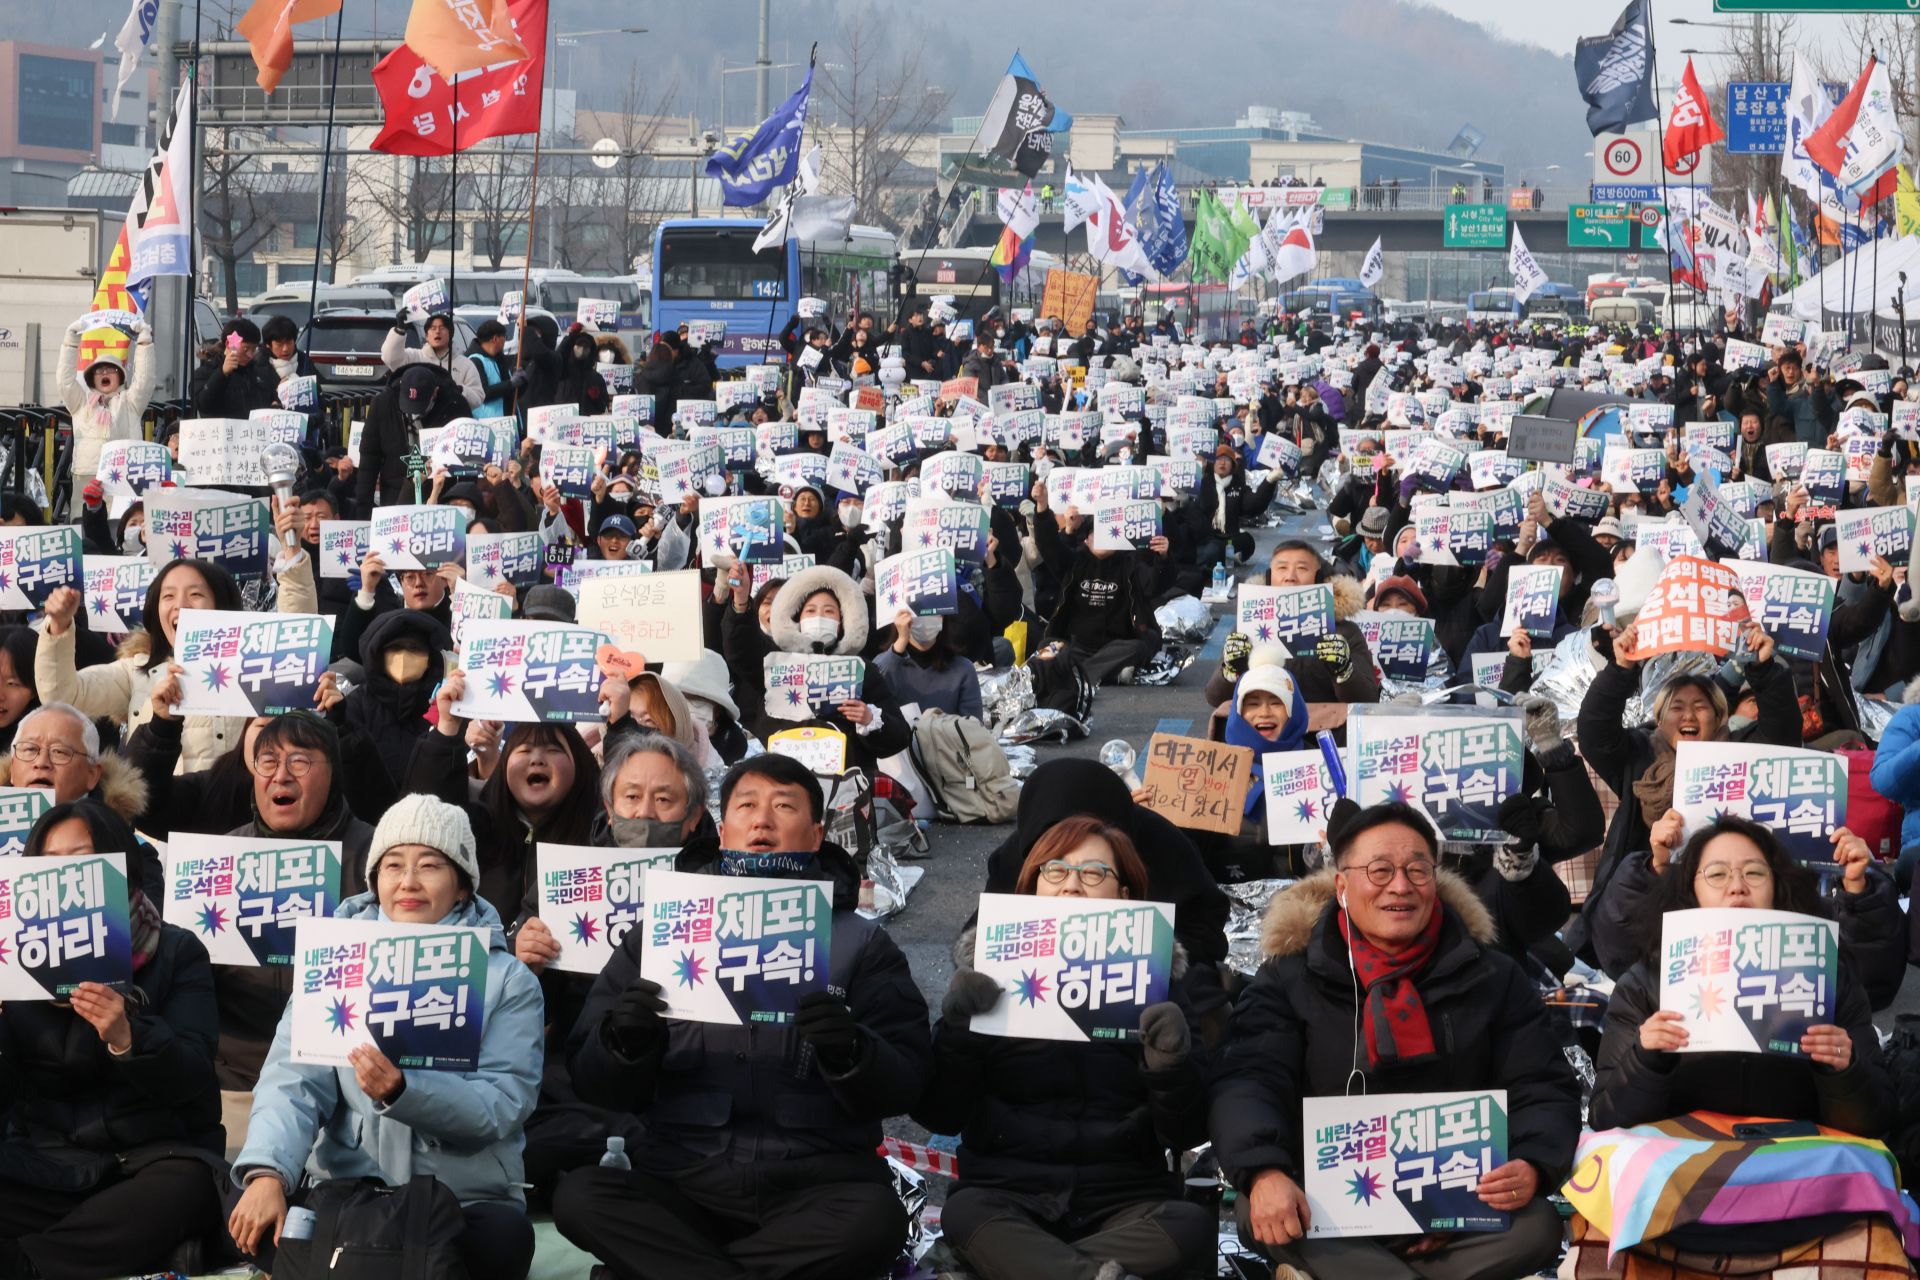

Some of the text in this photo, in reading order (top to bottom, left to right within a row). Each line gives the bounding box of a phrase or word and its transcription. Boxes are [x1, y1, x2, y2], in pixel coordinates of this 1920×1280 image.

[1615, 151, 1631, 163] 60
[1596, 187, 1648, 199] 전방600m
[1461, 211, 1477, 219] 시청
[1644, 211, 1656, 221] 60
[1460, 224, 1503, 233] 남산1호터널
[757, 281, 780, 296] 142
[0, 341, 19, 349] NDAI
[288, 379, 312, 393] 체포!
[288, 395, 312, 410] 구속!
[271, 414, 300, 428] 해체
[458, 423, 489, 440] 해체
[582, 421, 612, 437] 체포!
[770, 423, 796, 438] 체포!
[270, 429, 299, 443] 하라
[719, 430, 751, 448] 체포!
[770, 436, 796, 451] 구속!
[127, 446, 166, 464] 체포!
[455, 440, 488, 457] 하라
[555, 450, 589, 468] 체포!
[689, 449, 718, 468] 해체
[1429, 446, 1458, 467] 체포!
[661, 458, 687, 472] 내란동조
[943, 455, 976, 475] 해체
[1632, 451, 1661, 469] 체포!
[126, 466, 165, 487] 구속!
[555, 467, 586, 486] 구속!
[662, 466, 688, 478] 국민의힘
[991, 466, 1024, 483] 체포!
[1102, 471, 1137, 487] 체포!
[1418, 460, 1450, 482] 구속!
[1632, 467, 1660, 483] 구속!
[1807, 470, 1840, 489] 구속!
[942, 474, 974, 491] 하라
[991, 483, 1023, 500] 구속!
[1479, 491, 1515, 510] 체포!
[1569, 489, 1609, 510] 체포!
[152, 509, 192, 523] 내란수괴
[195, 502, 260, 536] 체포!
[375, 514, 409, 528] 내란동조
[411, 510, 456, 534] 해체
[703, 507, 728, 521] 내란수괴
[940, 506, 980, 529] 해체
[1125, 502, 1156, 521] 해체
[1420, 517, 1448, 526] 내란수괴
[1565, 502, 1605, 522] 구속!
[1714, 503, 1749, 540] 체포!
[151, 521, 192, 536] 윤석열
[375, 525, 409, 536] 국민의힘
[704, 517, 727, 534] 윤석열
[1124, 520, 1156, 541] 하라
[1420, 523, 1448, 535] 윤석열
[1450, 513, 1488, 532] 체포!
[1841, 517, 1871, 532] 내란동조
[1873, 510, 1908, 535] 해체
[324, 531, 353, 540] 내란수괴
[325, 538, 353, 550] 윤석열
[409, 534, 454, 556] 하라
[937, 528, 977, 550] 하라
[1450, 531, 1487, 552] 구속!
[1709, 518, 1741, 551] 구속!
[1876, 533, 1909, 556] 하라
[16, 531, 72, 561] 체포!
[197, 531, 259, 562] 구속!
[471, 544, 499, 554] 내란수괴
[501, 536, 538, 559] 체포!
[471, 551, 499, 564] 윤석열
[502, 555, 537, 578] 구속!
[549, 555, 570, 563] OUT
[769, 557, 809, 578] 체포!
[900, 552, 947, 578] 체포!
[18, 557, 73, 592] 구속!
[878, 565, 899, 583] 내란수괴
[601, 581, 668, 609] 윤석열을
[878, 574, 899, 596] 윤석열
[903, 575, 948, 602] 구속!
[1768, 576, 1827, 604] 체포!
[463, 594, 500, 619] 해체
[1242, 597, 1275, 609] 내란수괴
[1277, 587, 1326, 620] 체포!
[1520, 593, 1552, 620] 구속!
[1242, 608, 1275, 623] 윤석열
[1764, 606, 1822, 634] 구속!
[184, 625, 241, 643] 내란수괴
[243, 618, 319, 654] 체포!
[1278, 612, 1327, 643] 구속!
[1380, 621, 1425, 642] 체포!
[1637, 615, 1741, 651] 파면 퇴진
[183, 641, 239, 662] 윤석열
[469, 634, 525, 652] 내란수괴
[527, 632, 604, 664] 체포!
[467, 649, 522, 670] 윤석열
[1378, 643, 1423, 665] 구속!
[240, 652, 316, 693] 구속!
[770, 664, 805, 674] 내란수괴
[807, 660, 857, 685] 체포!
[524, 663, 600, 699] 구속!
[770, 674, 804, 687] 윤석열
[807, 683, 857, 710] 구속!
[1359, 735, 1419, 758] 내란수괴
[1423, 724, 1507, 772] 체포!
[1154, 740, 1238, 779] 대구에서
[1359, 752, 1419, 779] 윤석열
[1182, 767, 1228, 795] 열받아
[1270, 764, 1316, 784] 내란동조
[1685, 762, 1747, 782] 내란수괴
[1752, 760, 1834, 800] 체포!
[1271, 780, 1318, 797] 국민의힘
[1424, 768, 1507, 813] 구속!
[1684, 779, 1745, 805] 윤석열
[1191, 794, 1236, 823] 왔다
[176, 856, 234, 878] 내란수괴
[239, 848, 326, 893] 체포!
[545, 867, 603, 886] 내란동조
[16, 860, 106, 919] 해체
[174, 874, 233, 901] 윤석열
[546, 885, 603, 905] 국민의힘
[239, 893, 323, 938] 구속!
[653, 897, 714, 920] 내란수괴
[719, 887, 816, 941] 체포!
[19, 912, 108, 969] 하라
[652, 917, 713, 947] 윤석열
[986, 918, 1057, 942] 내란동조
[1062, 910, 1154, 961] 해체
[304, 942, 367, 967] 내란수괴
[986, 937, 1056, 962] 국민의힘
[1669, 929, 1732, 959] 내란수괴
[1737, 926, 1827, 971] 체포!
[370, 935, 472, 986] 체포!
[718, 938, 814, 992] 구속!
[1668, 949, 1730, 985] 윤석열
[303, 964, 364, 994] 윤석열
[1060, 959, 1151, 1010] 하라
[1737, 972, 1826, 1020] 구속!
[368, 984, 469, 1037] 구속!
[1316, 1115, 1387, 1145] 내란수괴
[1394, 1098, 1491, 1154] 체포!
[1317, 1135, 1387, 1171] 윤석열
[1396, 1147, 1492, 1203] 구속!
